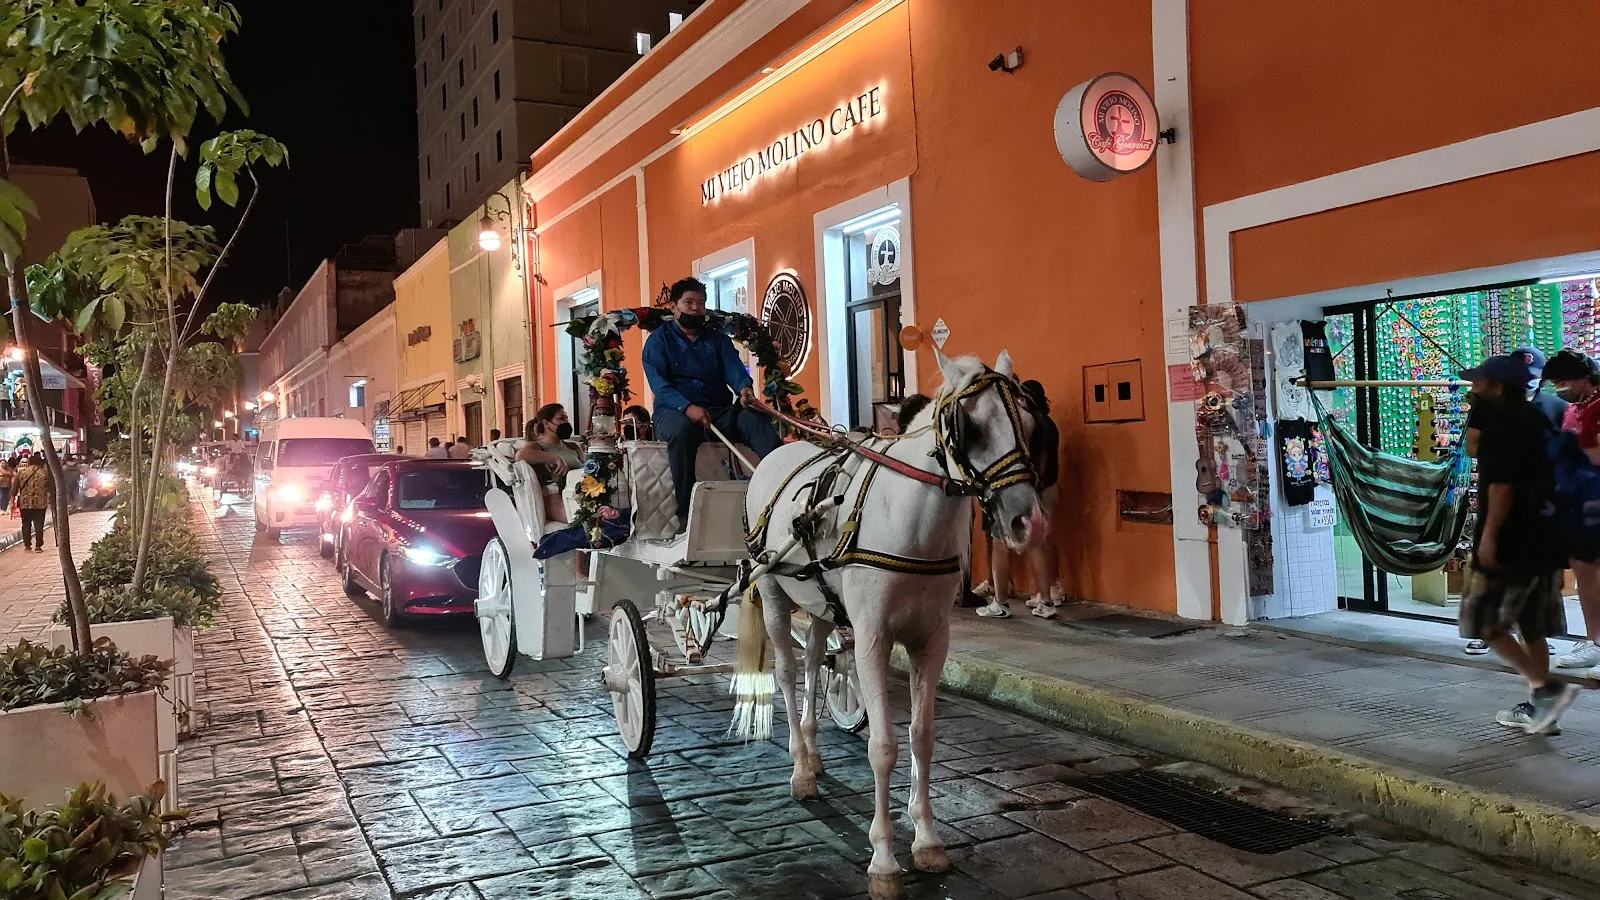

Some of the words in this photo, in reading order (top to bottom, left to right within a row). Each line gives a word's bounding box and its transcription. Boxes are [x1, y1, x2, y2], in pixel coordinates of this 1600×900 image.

[1101, 97, 1117, 110] VIEJO
[1119, 97, 1139, 125] MOLINO
[1099, 112, 1105, 123] MI
[700, 176, 716, 205] MI
[718, 157, 755, 193] VIEJO
[757, 118, 825, 175] MOLINO
[830, 86, 881, 136] CAFE
[1089, 134, 1112, 152] Café
[1113, 134, 1152, 151] Gourmet
[761, 312, 770, 327] MI
[766, 283, 782, 309] VIEJO
[782, 281, 804, 317] MOLINO
